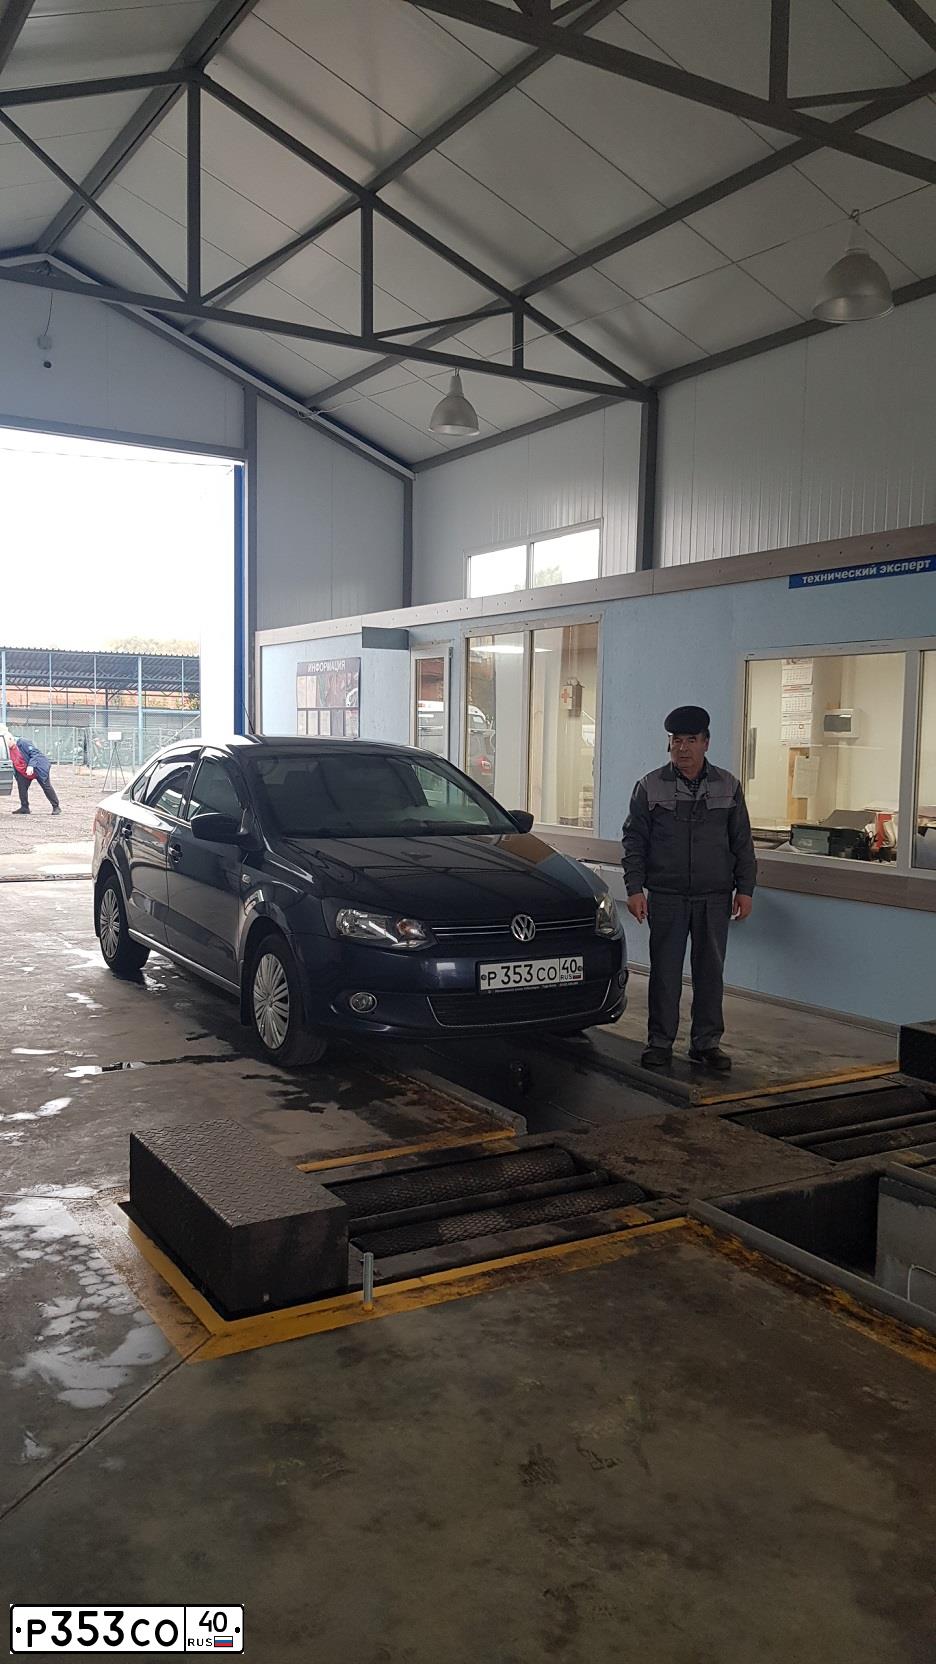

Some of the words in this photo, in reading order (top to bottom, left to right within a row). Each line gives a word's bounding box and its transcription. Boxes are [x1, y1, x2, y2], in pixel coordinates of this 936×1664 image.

[802, 565, 877, 584] технический
[879, 559, 931, 574] эксперт
[308, 660, 346, 673] ИНФОРМАЦИЯ
[561, 959, 577, 974] 40
